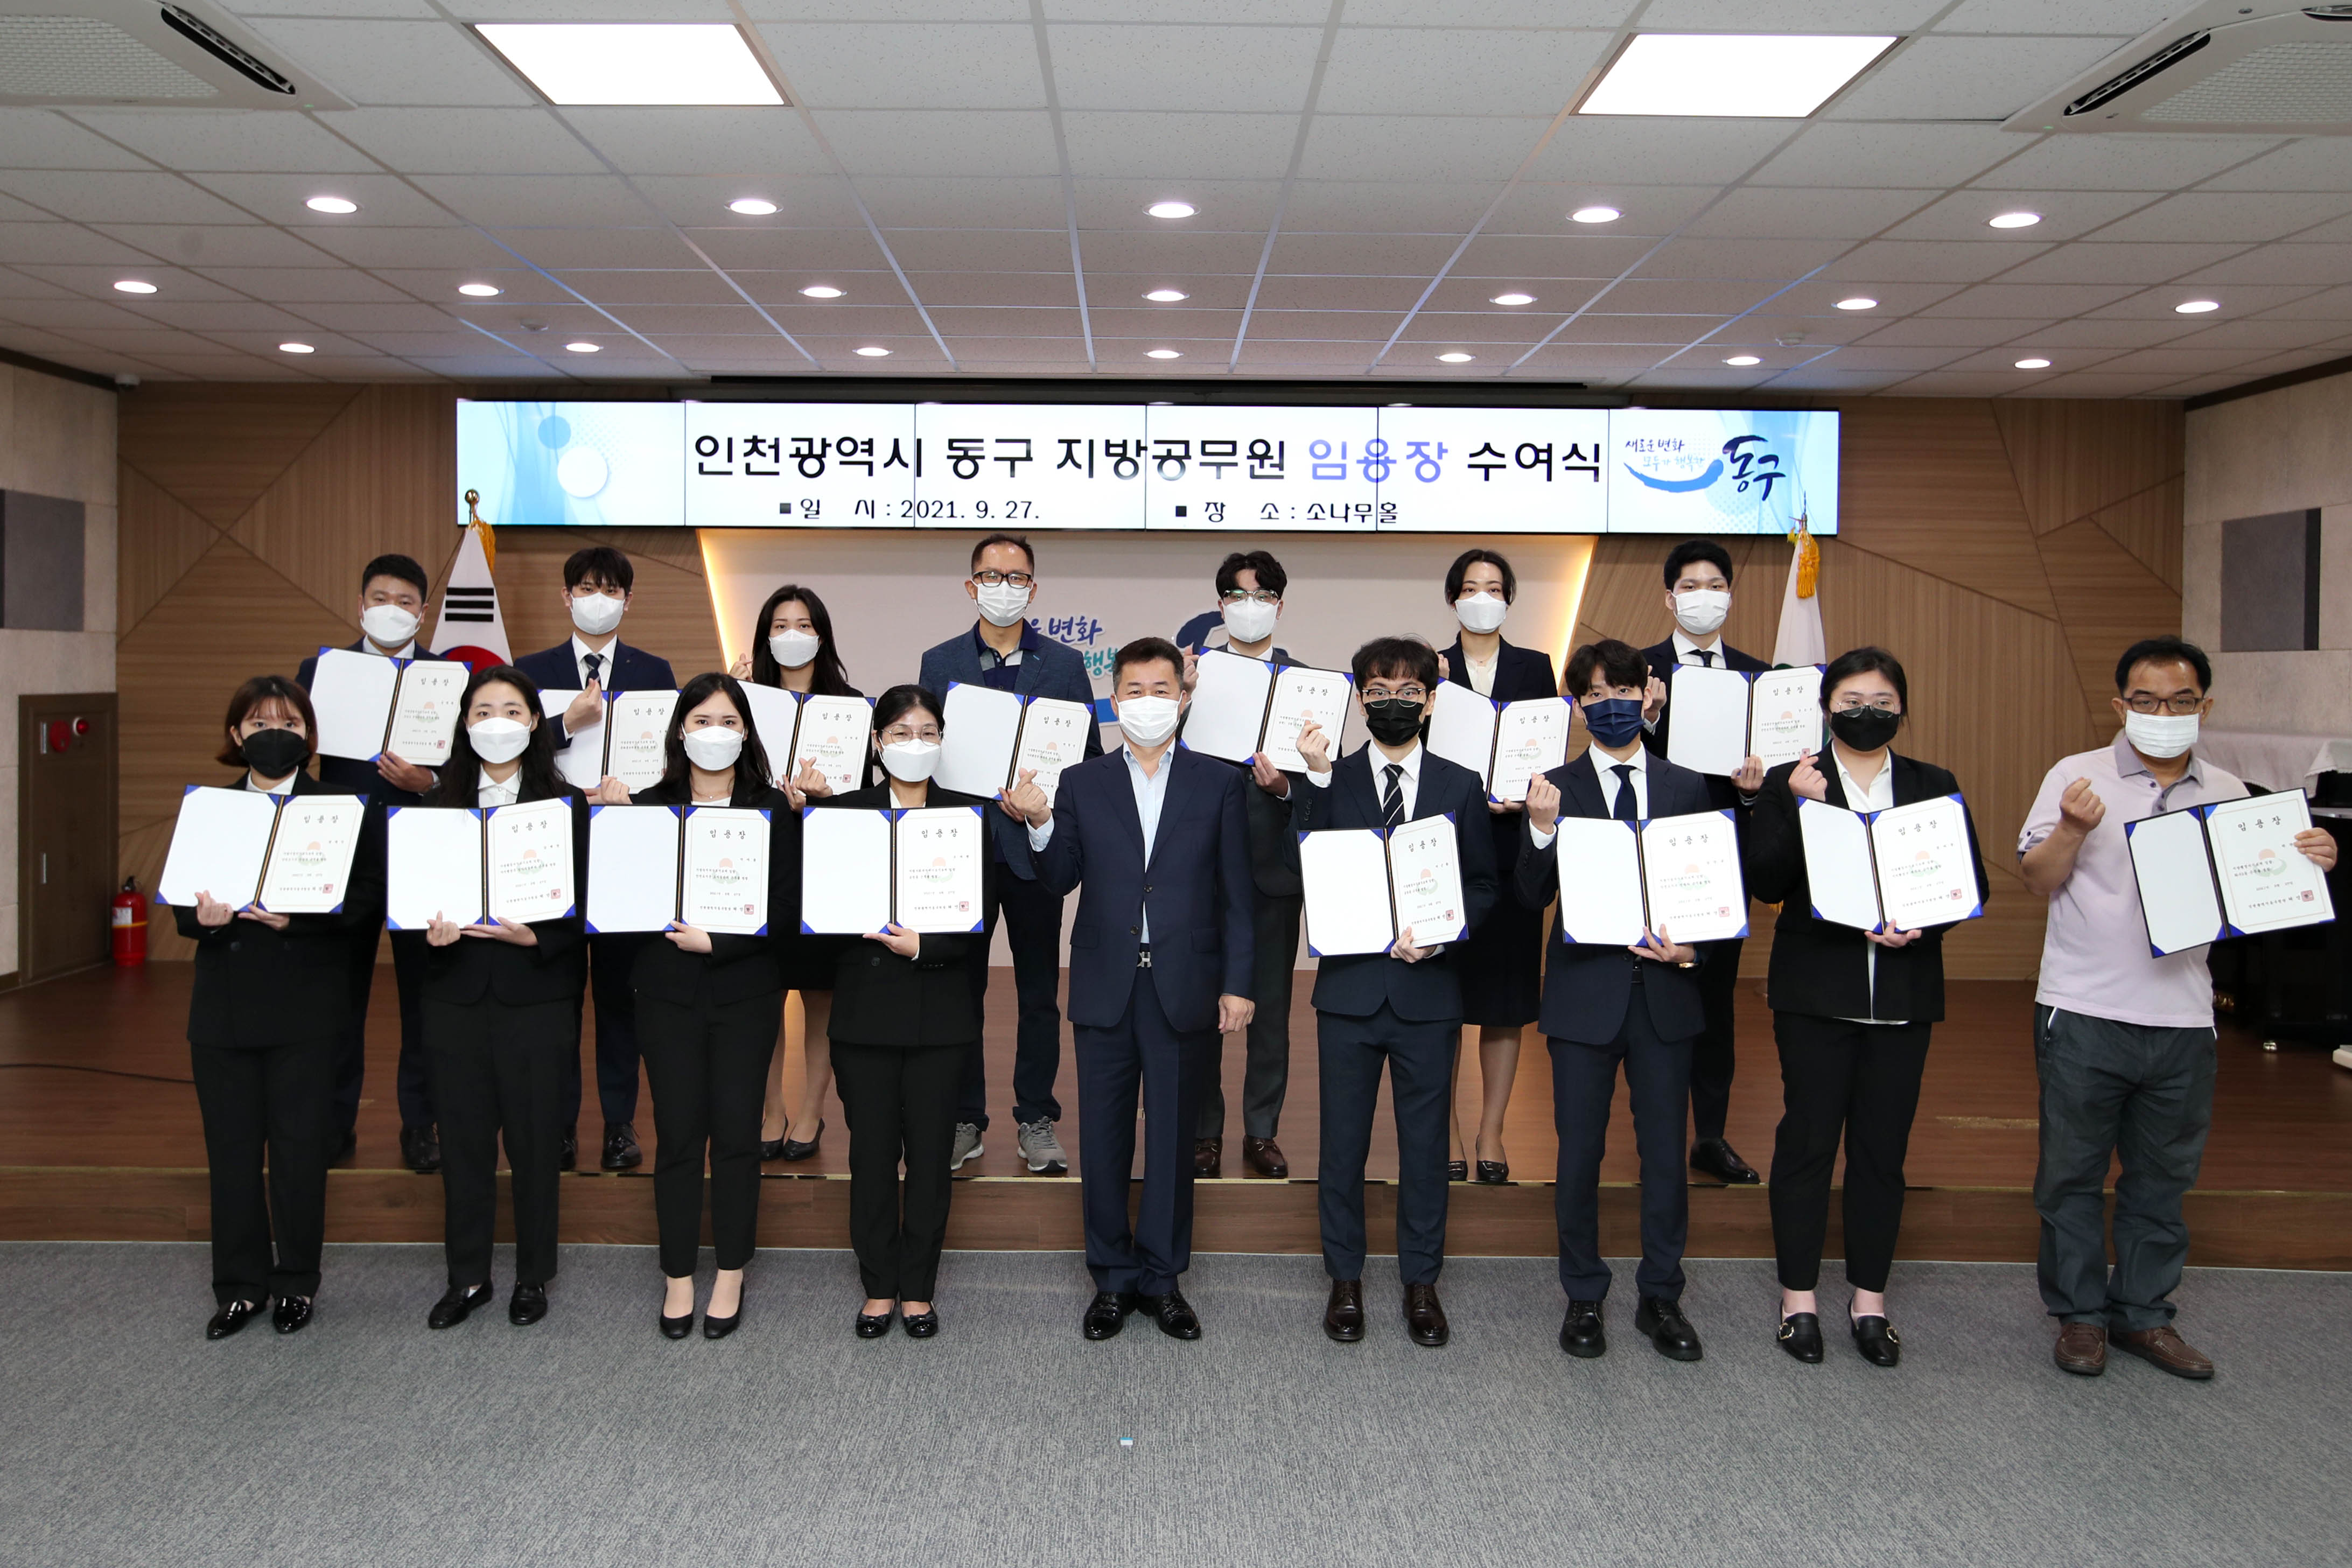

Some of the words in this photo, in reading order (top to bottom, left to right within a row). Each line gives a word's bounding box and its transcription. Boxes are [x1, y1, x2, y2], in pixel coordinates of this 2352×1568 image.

[695, 435, 922, 478] 인천광역시
[946, 438, 1033, 480] 동구
[1057, 439, 1285, 481] 지방공무원
[1309, 438, 1448, 483] 임용장
[1467, 442, 1600, 482] 수여식
[1658, 438, 1685, 452] 변화
[1723, 435, 1786, 501] 동구
[1048, 615, 1102, 645] 변화
